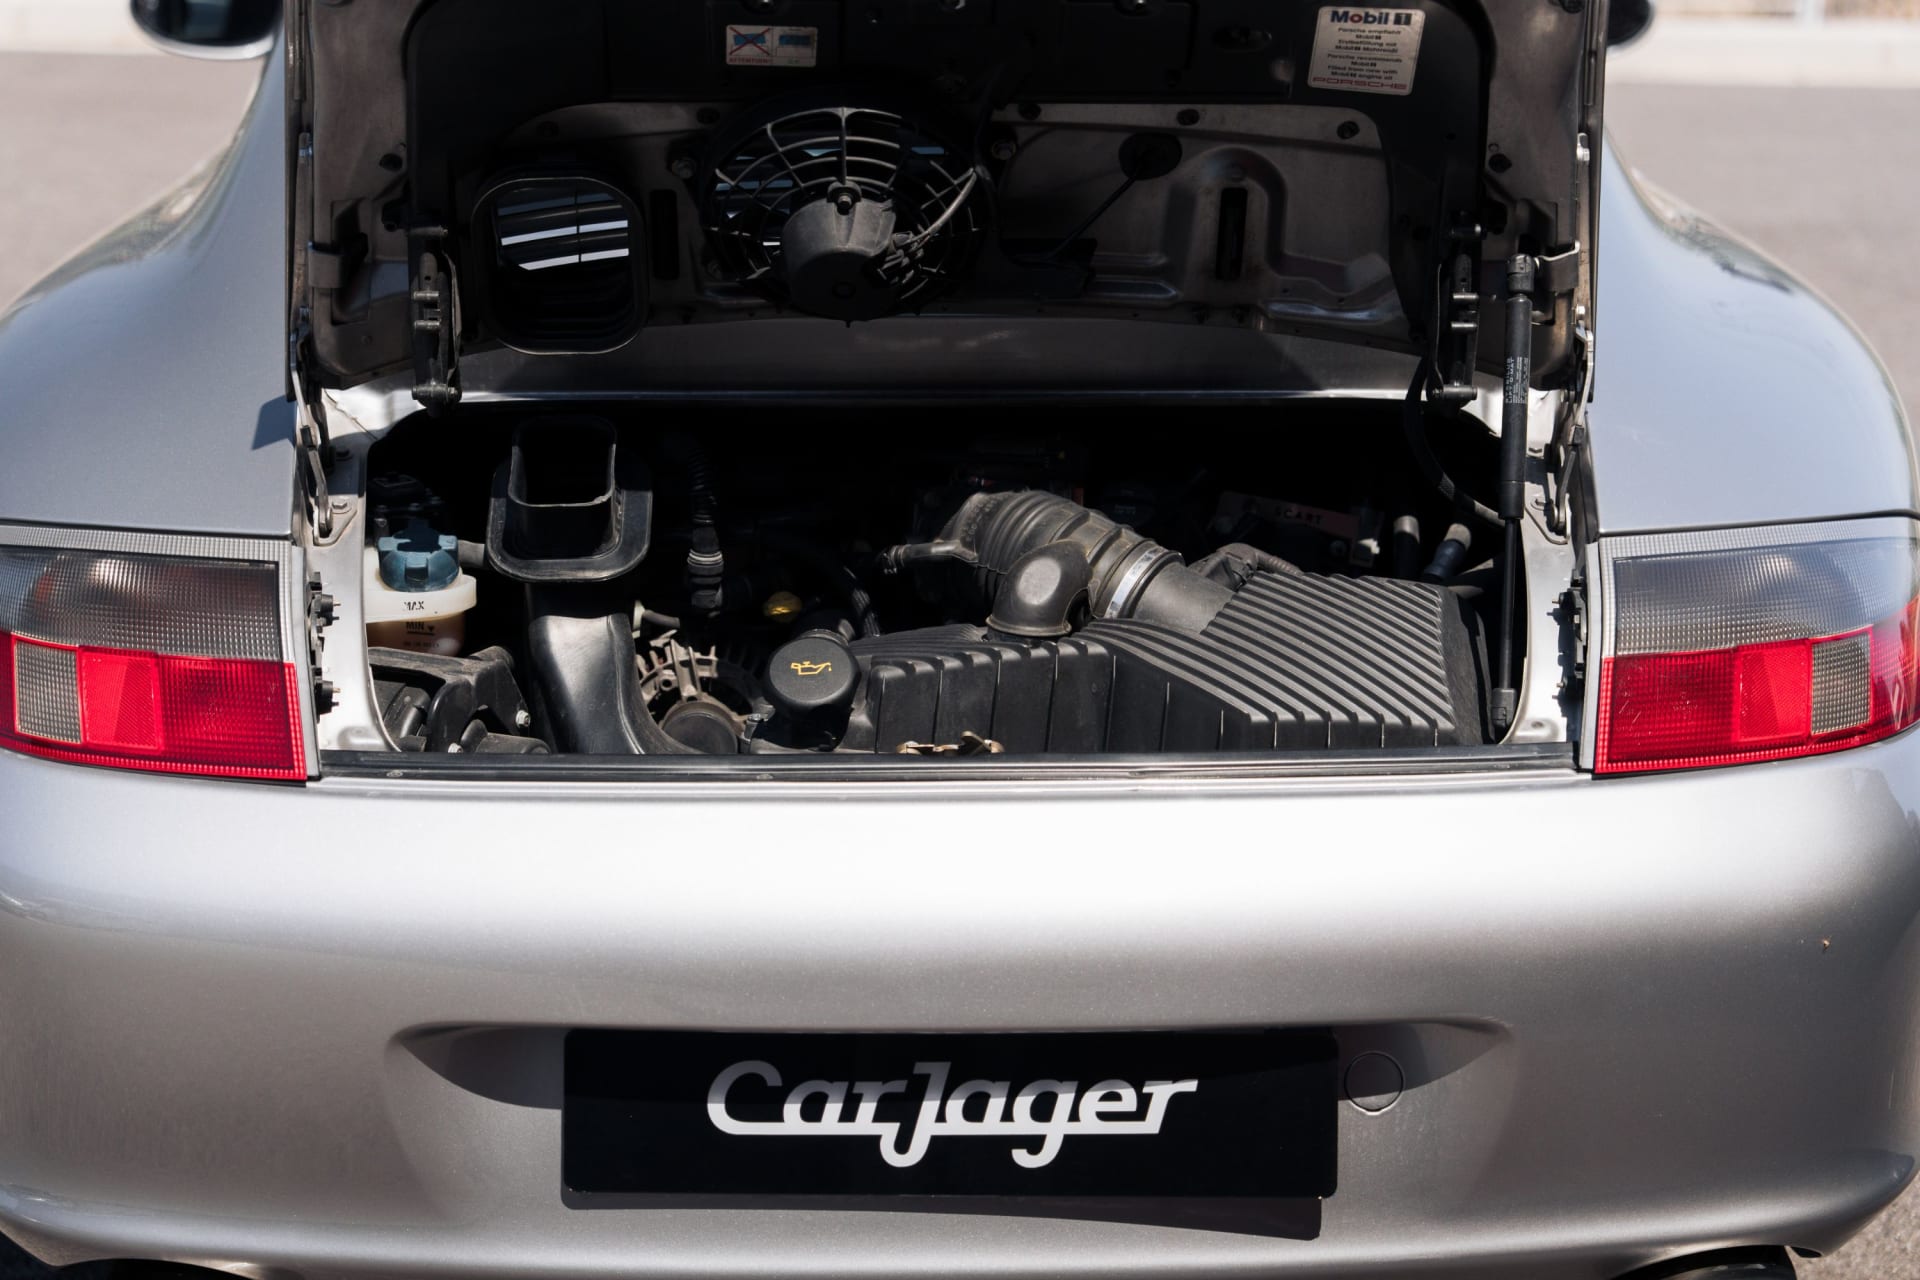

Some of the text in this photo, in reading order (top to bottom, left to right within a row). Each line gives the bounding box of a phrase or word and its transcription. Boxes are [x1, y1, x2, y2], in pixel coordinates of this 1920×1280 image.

[1330, 10, 1390, 25] Mobil
[1312, 77, 1407, 90] PORSCHE
[706, 1059, 1200, 1170] CarJager
